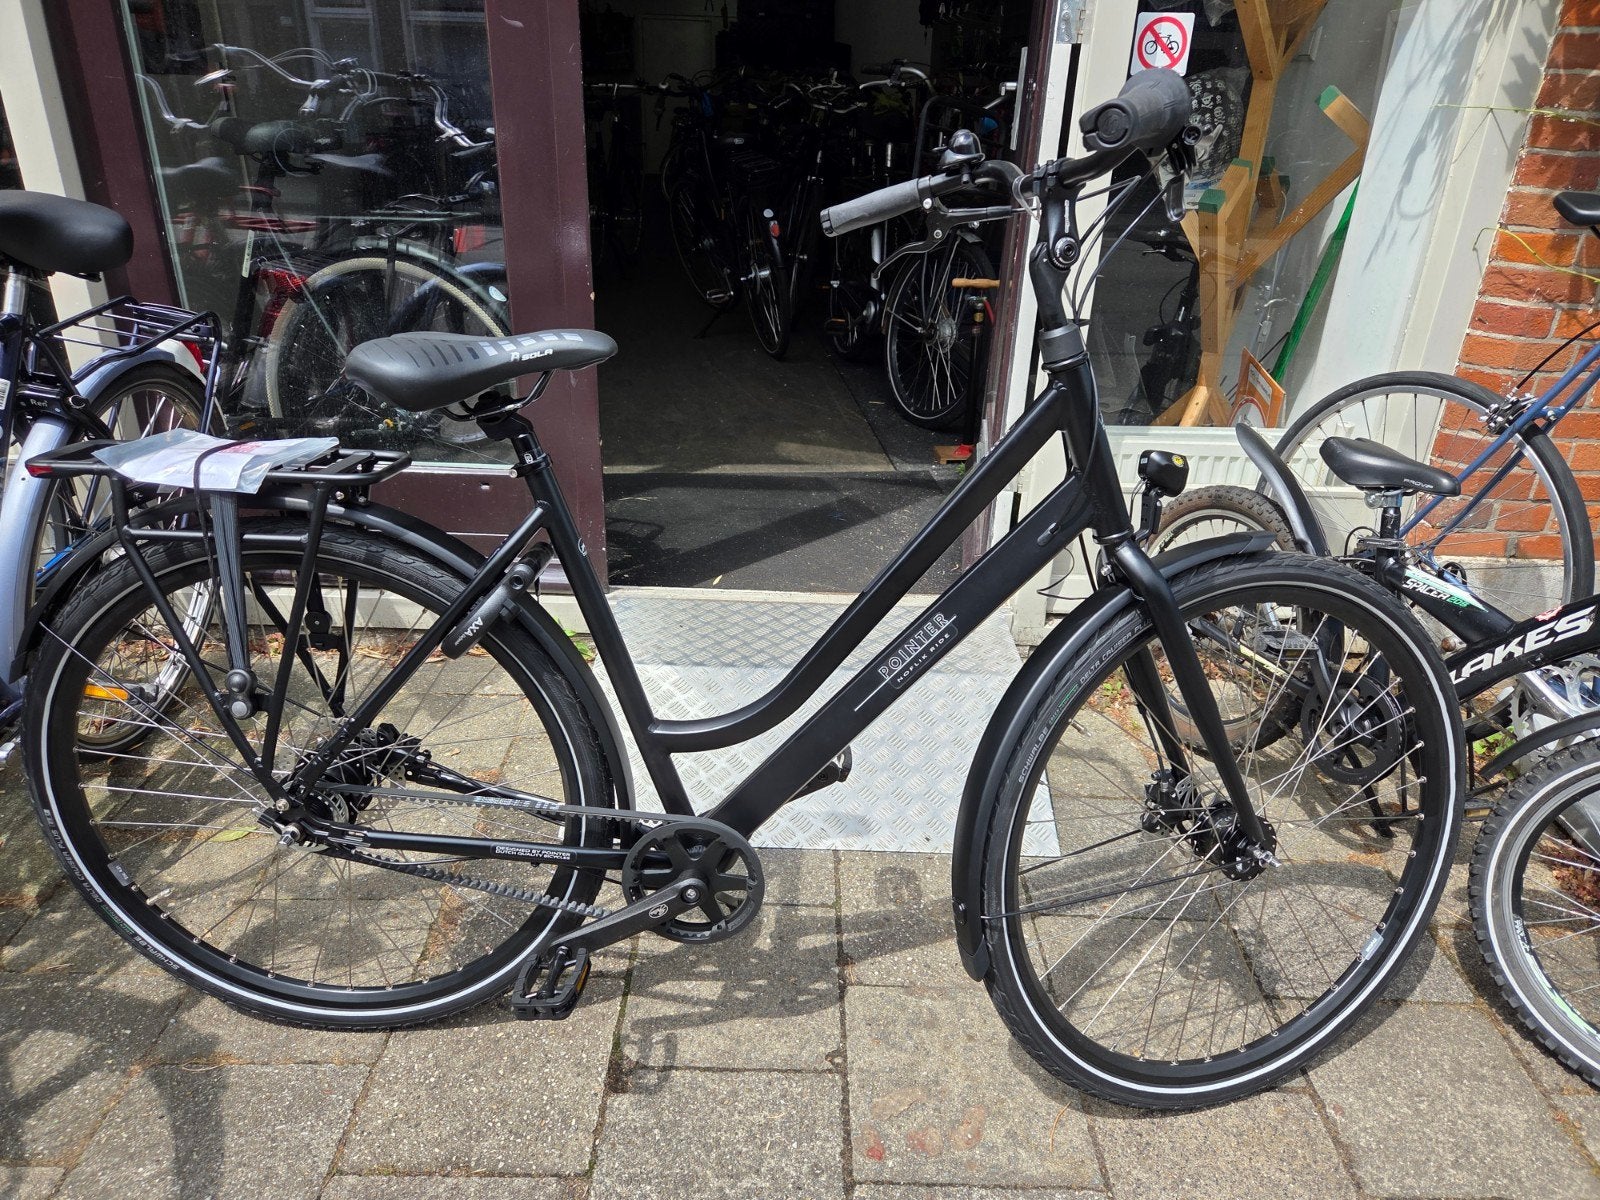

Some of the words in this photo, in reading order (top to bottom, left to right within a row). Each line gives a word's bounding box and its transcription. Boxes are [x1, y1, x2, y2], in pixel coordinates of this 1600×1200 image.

[1402, 579, 1452, 600] SPACER
[464, 616, 483, 637] AXA
[877, 613, 949, 680] POINTER
[929, 633, 950, 653] RIDE
[1018, 726, 1049, 783] SCHWALBE
[1079, 660, 1100, 684] DELTA
[1101, 633, 1132, 661] CRUISER
[52, 829, 66, 850] PLUS
[495, 845, 531, 853] DESIGNED
[63, 851, 85, 881] CRUISER
[83, 882, 103, 903] DELTA
[134, 935, 180, 971] SCHWALBE
